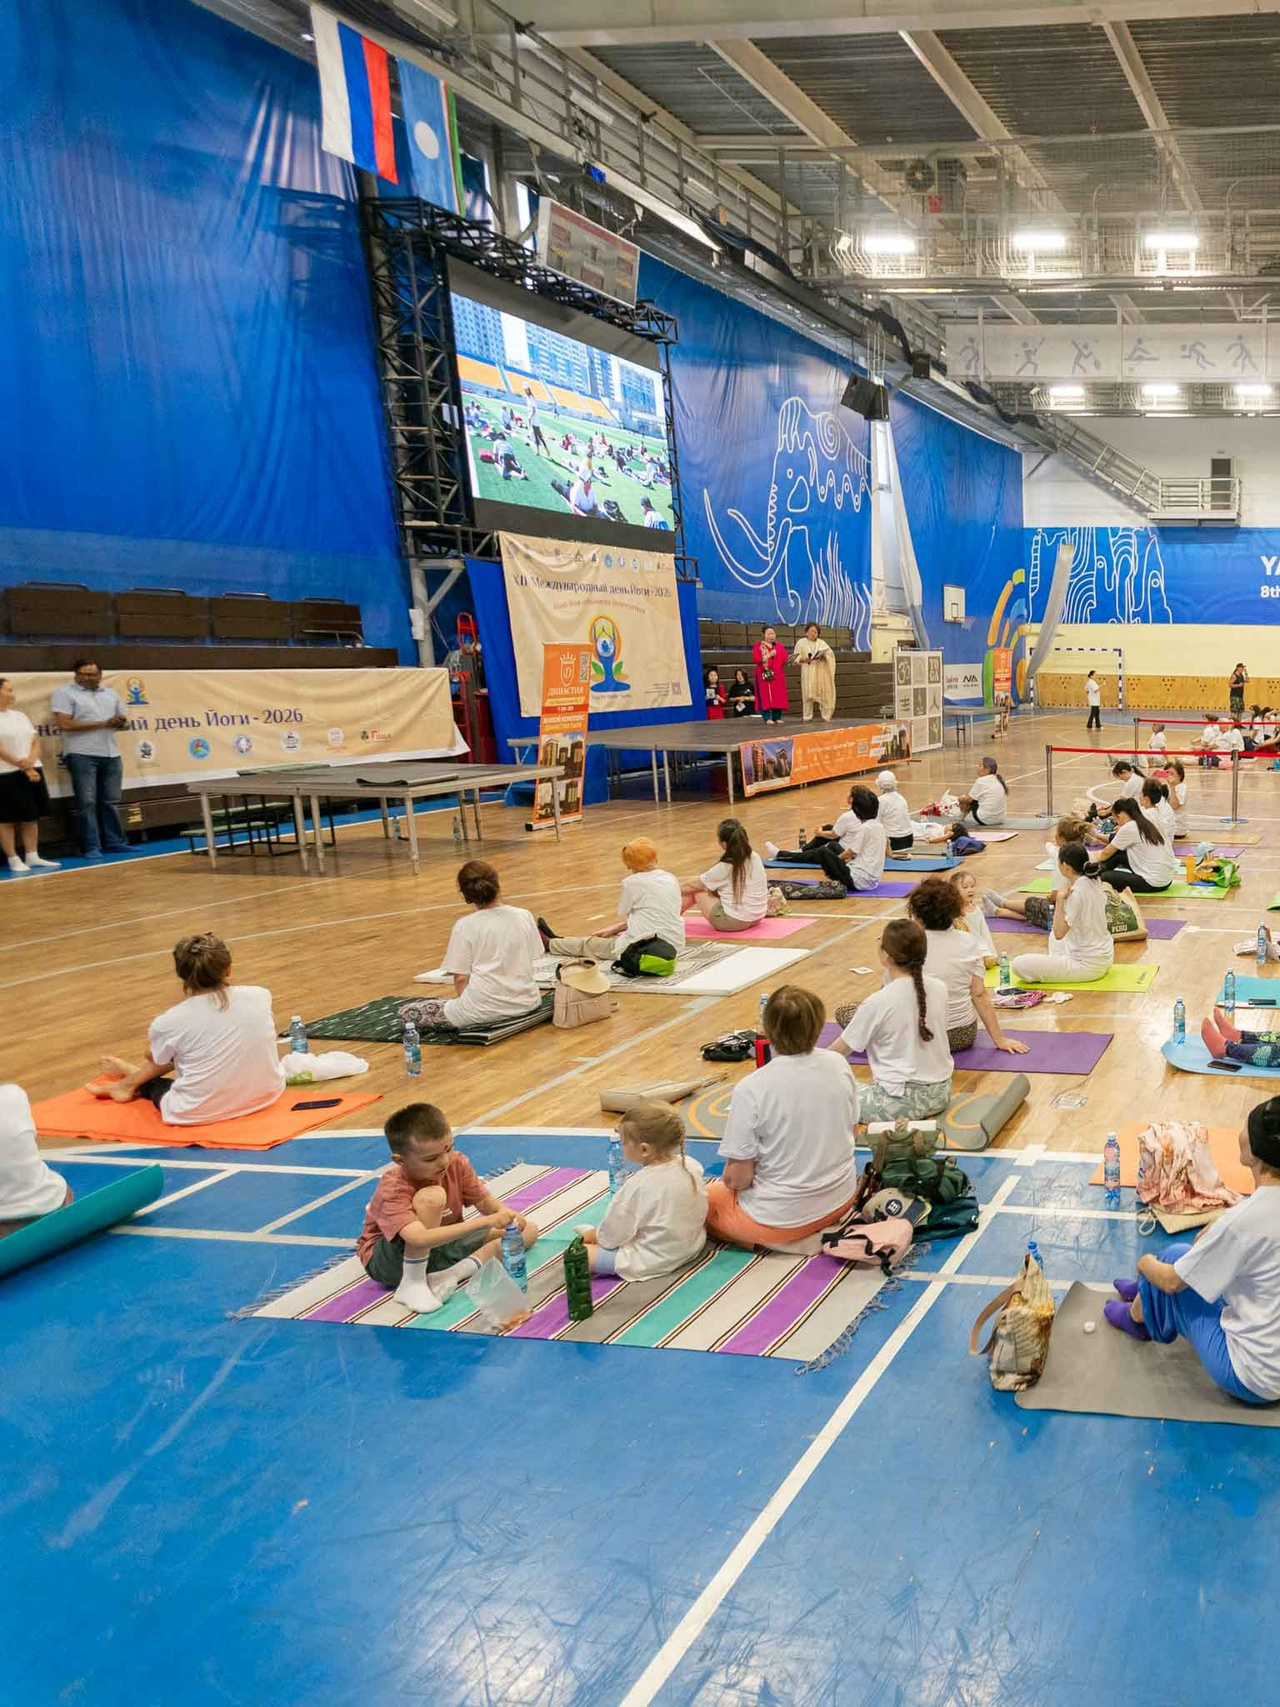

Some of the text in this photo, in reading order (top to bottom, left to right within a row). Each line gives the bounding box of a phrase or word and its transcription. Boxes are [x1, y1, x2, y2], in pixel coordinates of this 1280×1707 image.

[154, 716, 200, 732] день
[205, 709, 250, 727] Йоги
[263, 708, 303, 724] 2026
